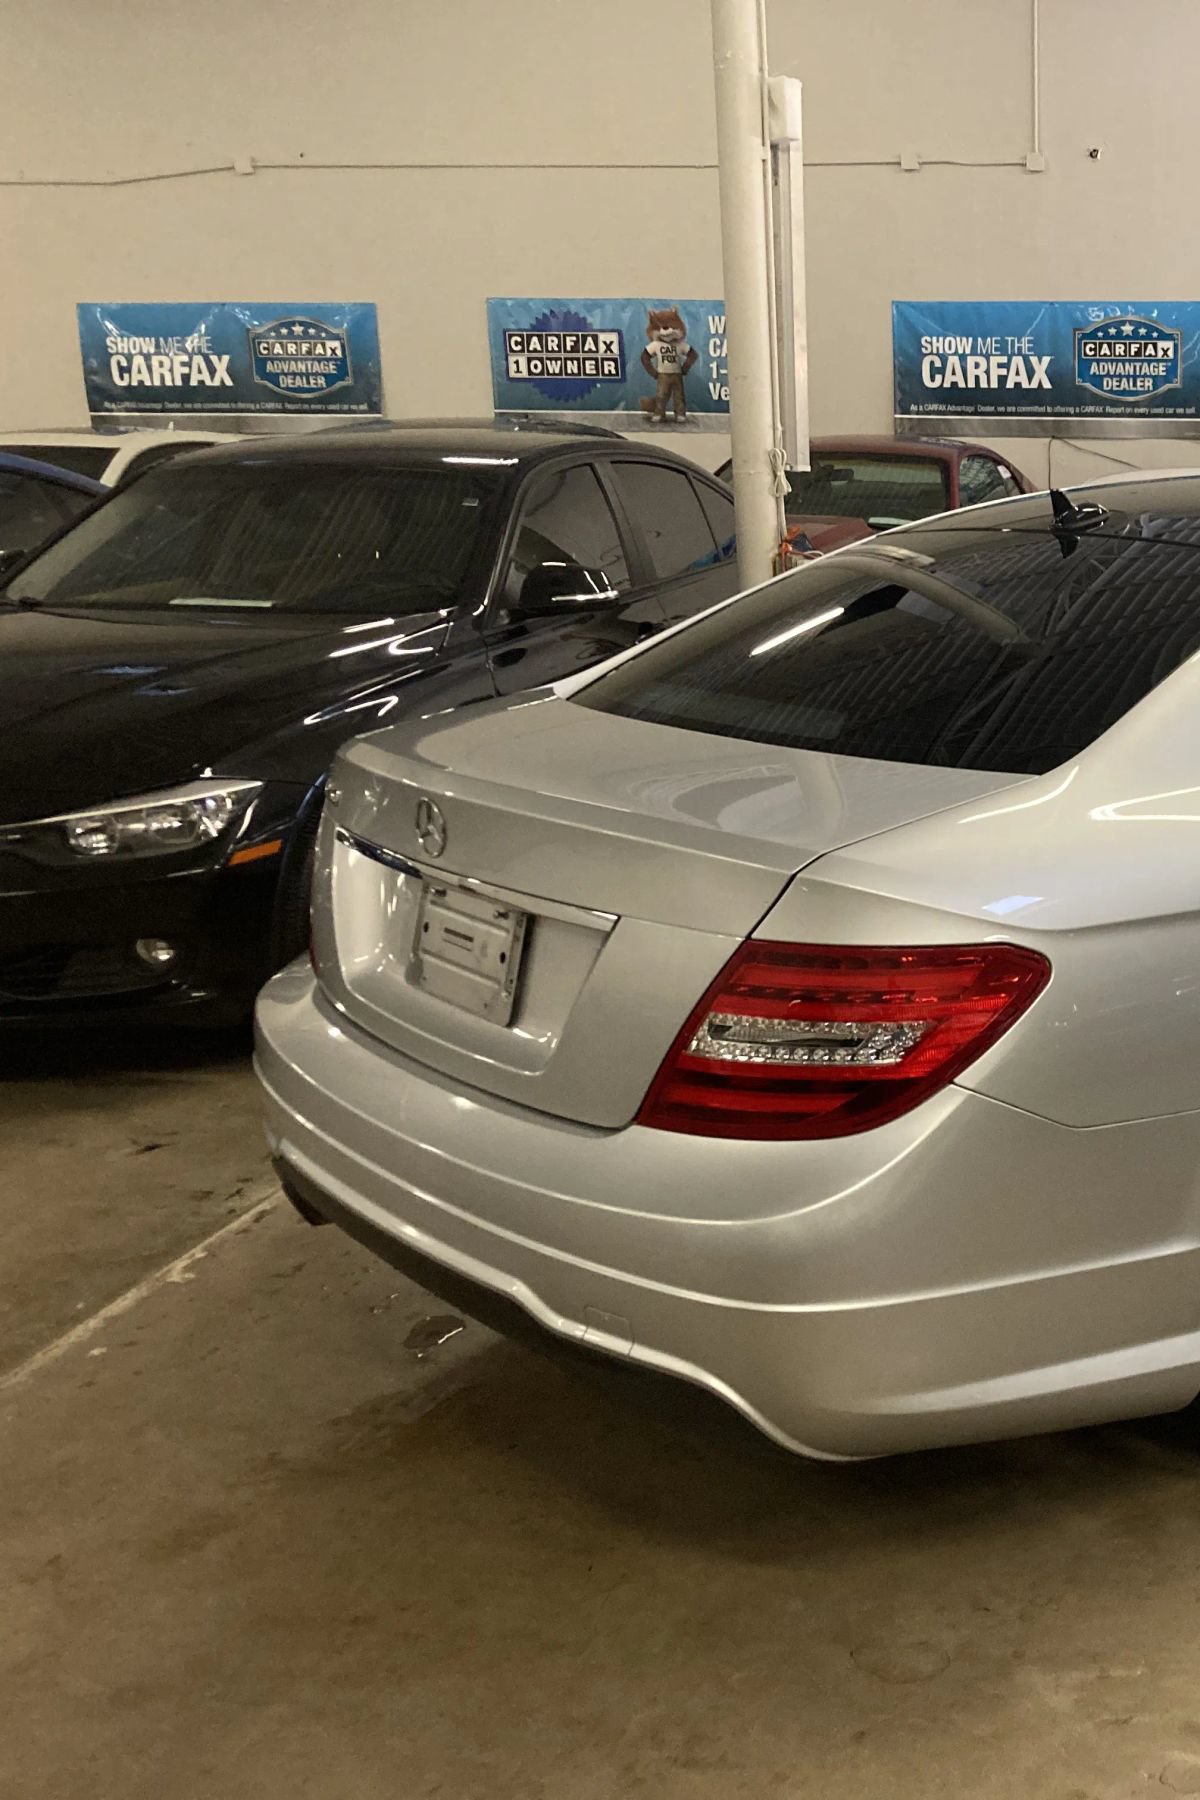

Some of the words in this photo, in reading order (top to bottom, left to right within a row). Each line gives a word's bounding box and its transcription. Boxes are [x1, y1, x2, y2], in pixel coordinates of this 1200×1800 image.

[106, 336, 155, 354] SHOW
[159, 337, 183, 354] ME
[184, 336, 213, 354] THE
[260, 342, 338, 356] CARFAX
[510, 336, 614, 354] CARFAX
[660, 345, 677, 355] CAR
[921, 336, 973, 355] SHOW
[977, 337, 1001, 355] ME
[1005, 337, 1035, 355] THE
[1085, 343, 1175, 358] CARFAX
[513, 359, 522, 374] 1
[529, 360, 616, 374] OWNER
[661, 355, 677, 364] FOX
[110, 354, 234, 386] CARFAX
[266, 360, 338, 374] ADVANTAGE
[922, 355, 1052, 389] CARFAX
[1090, 361, 1167, 375] ADVANTAGE
[279, 375, 327, 388] DEALER
[1103, 377, 1154, 391] DEALER
